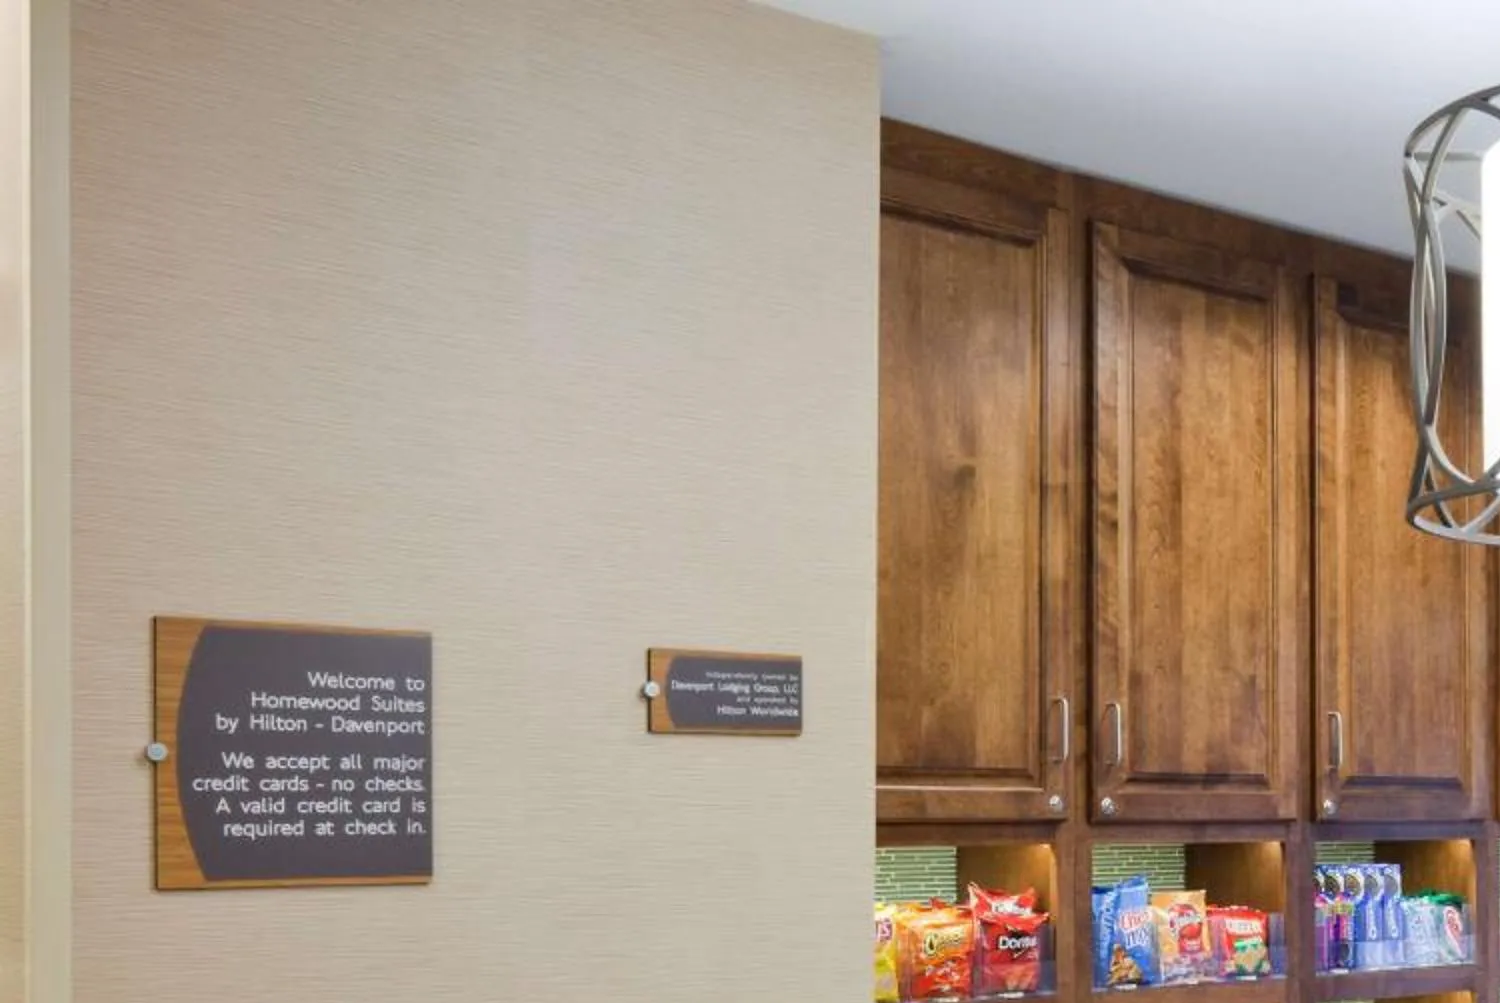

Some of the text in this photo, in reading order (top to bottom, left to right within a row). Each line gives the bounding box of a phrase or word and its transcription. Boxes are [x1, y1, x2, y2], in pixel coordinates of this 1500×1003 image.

[307, 671, 425, 691] Welcome to
[251, 691, 425, 713] Homewood Suites
[215, 713, 239, 734] by
[250, 715, 308, 732] Hilton
[331, 716, 425, 737] Davenport
[221, 751, 425, 773] We accept all major
[192, 775, 249, 792] credit
[259, 775, 309, 792] cards
[332, 779, 354, 792] no
[215, 797, 426, 814] A valid credit card is
[223, 818, 427, 840] required at check in.
